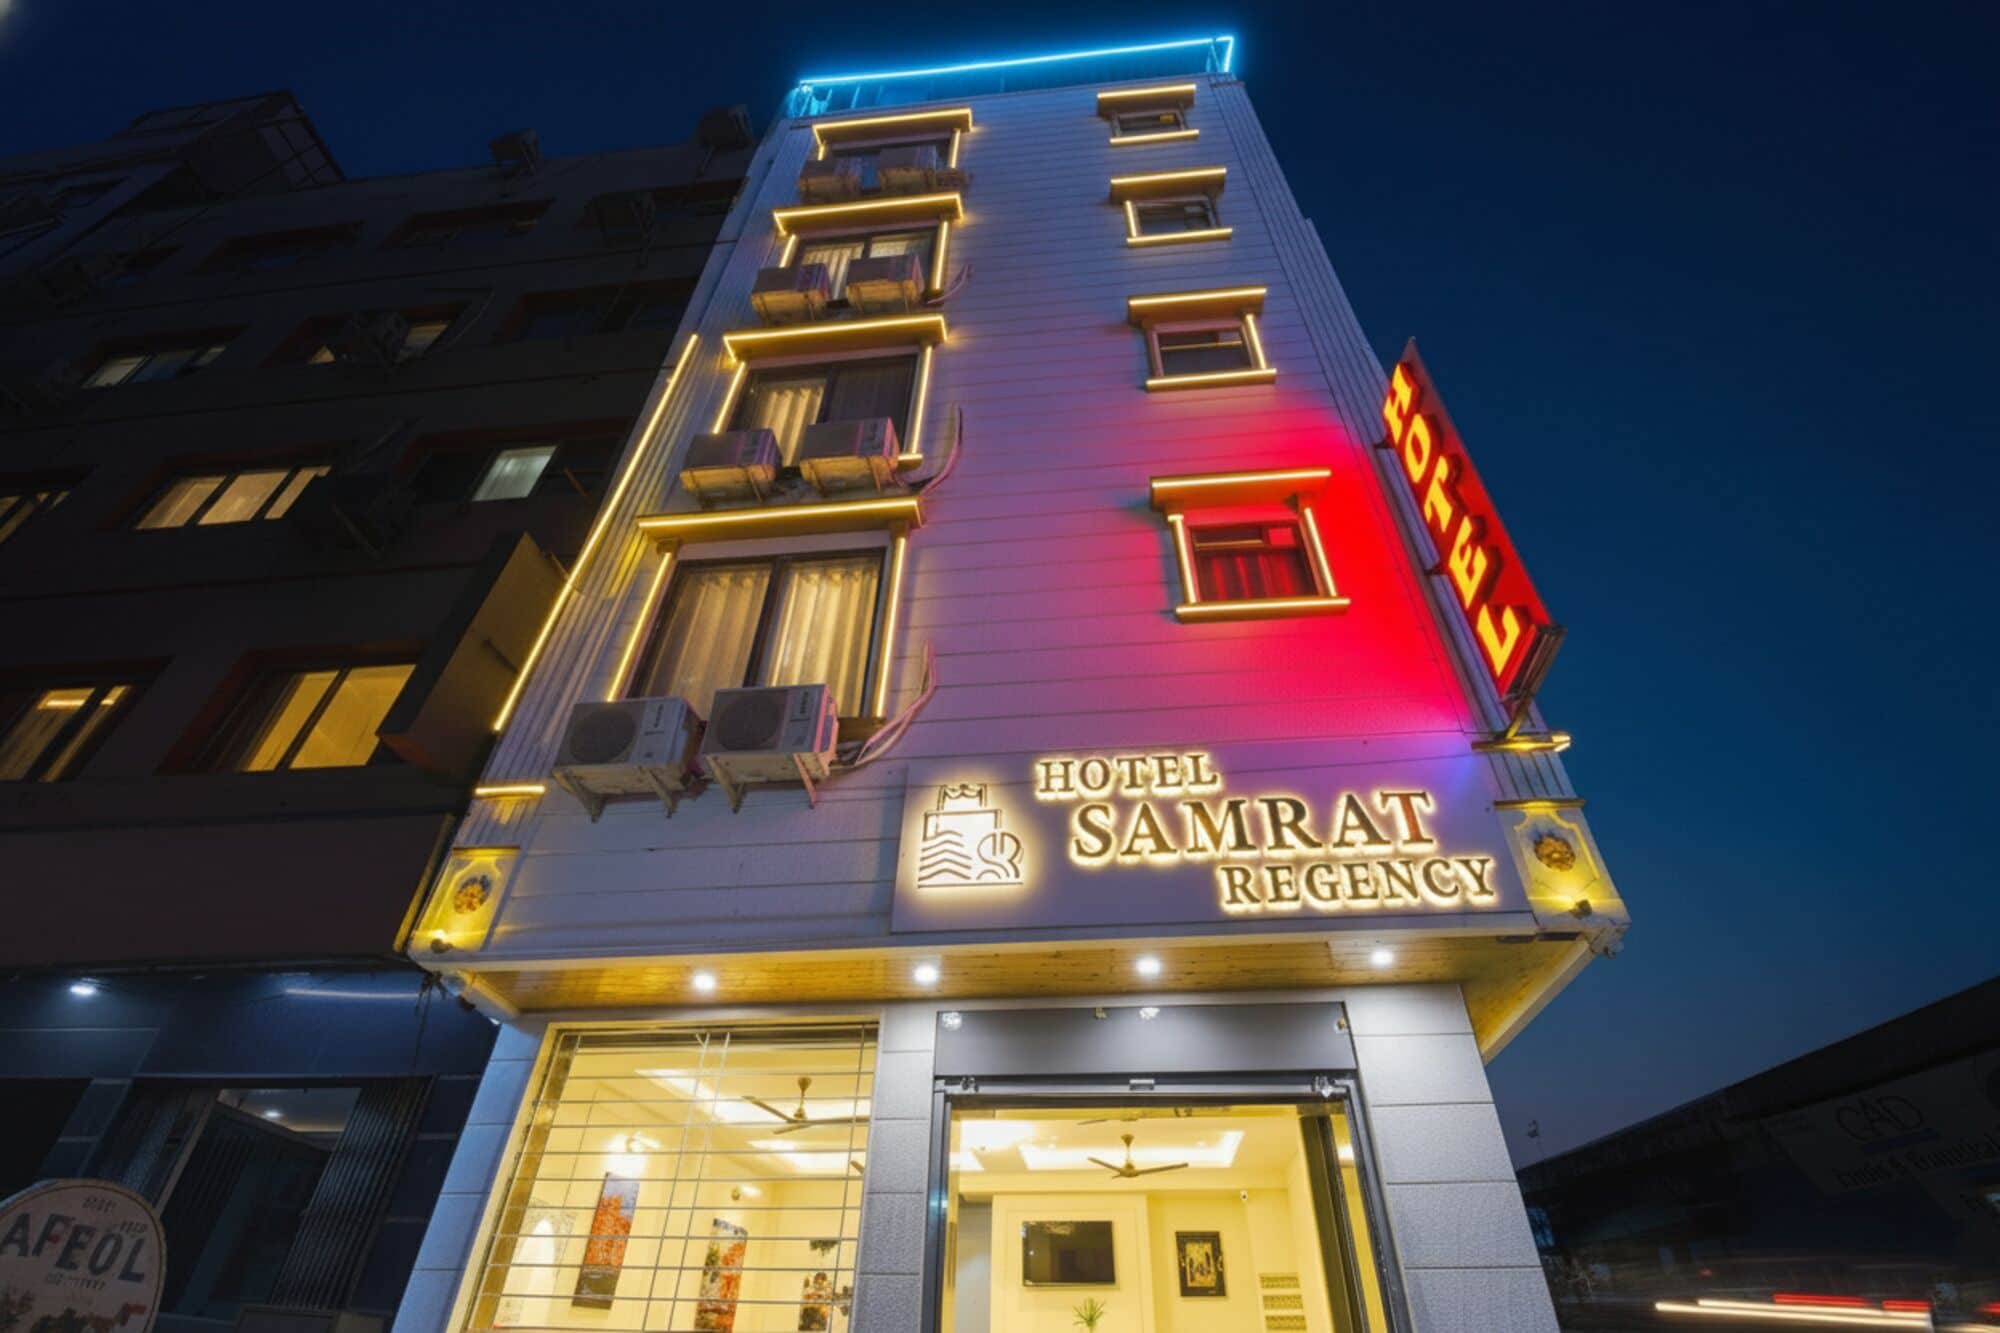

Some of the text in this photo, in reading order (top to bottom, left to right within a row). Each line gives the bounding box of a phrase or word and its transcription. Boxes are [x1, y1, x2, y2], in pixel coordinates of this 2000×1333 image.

[1383, 362, 1522, 678] HOTEL
[1038, 754, 1218, 795] HOTEL
[1073, 790, 1435, 858] SAMRAT
[1219, 857, 1496, 906] REGENCY
